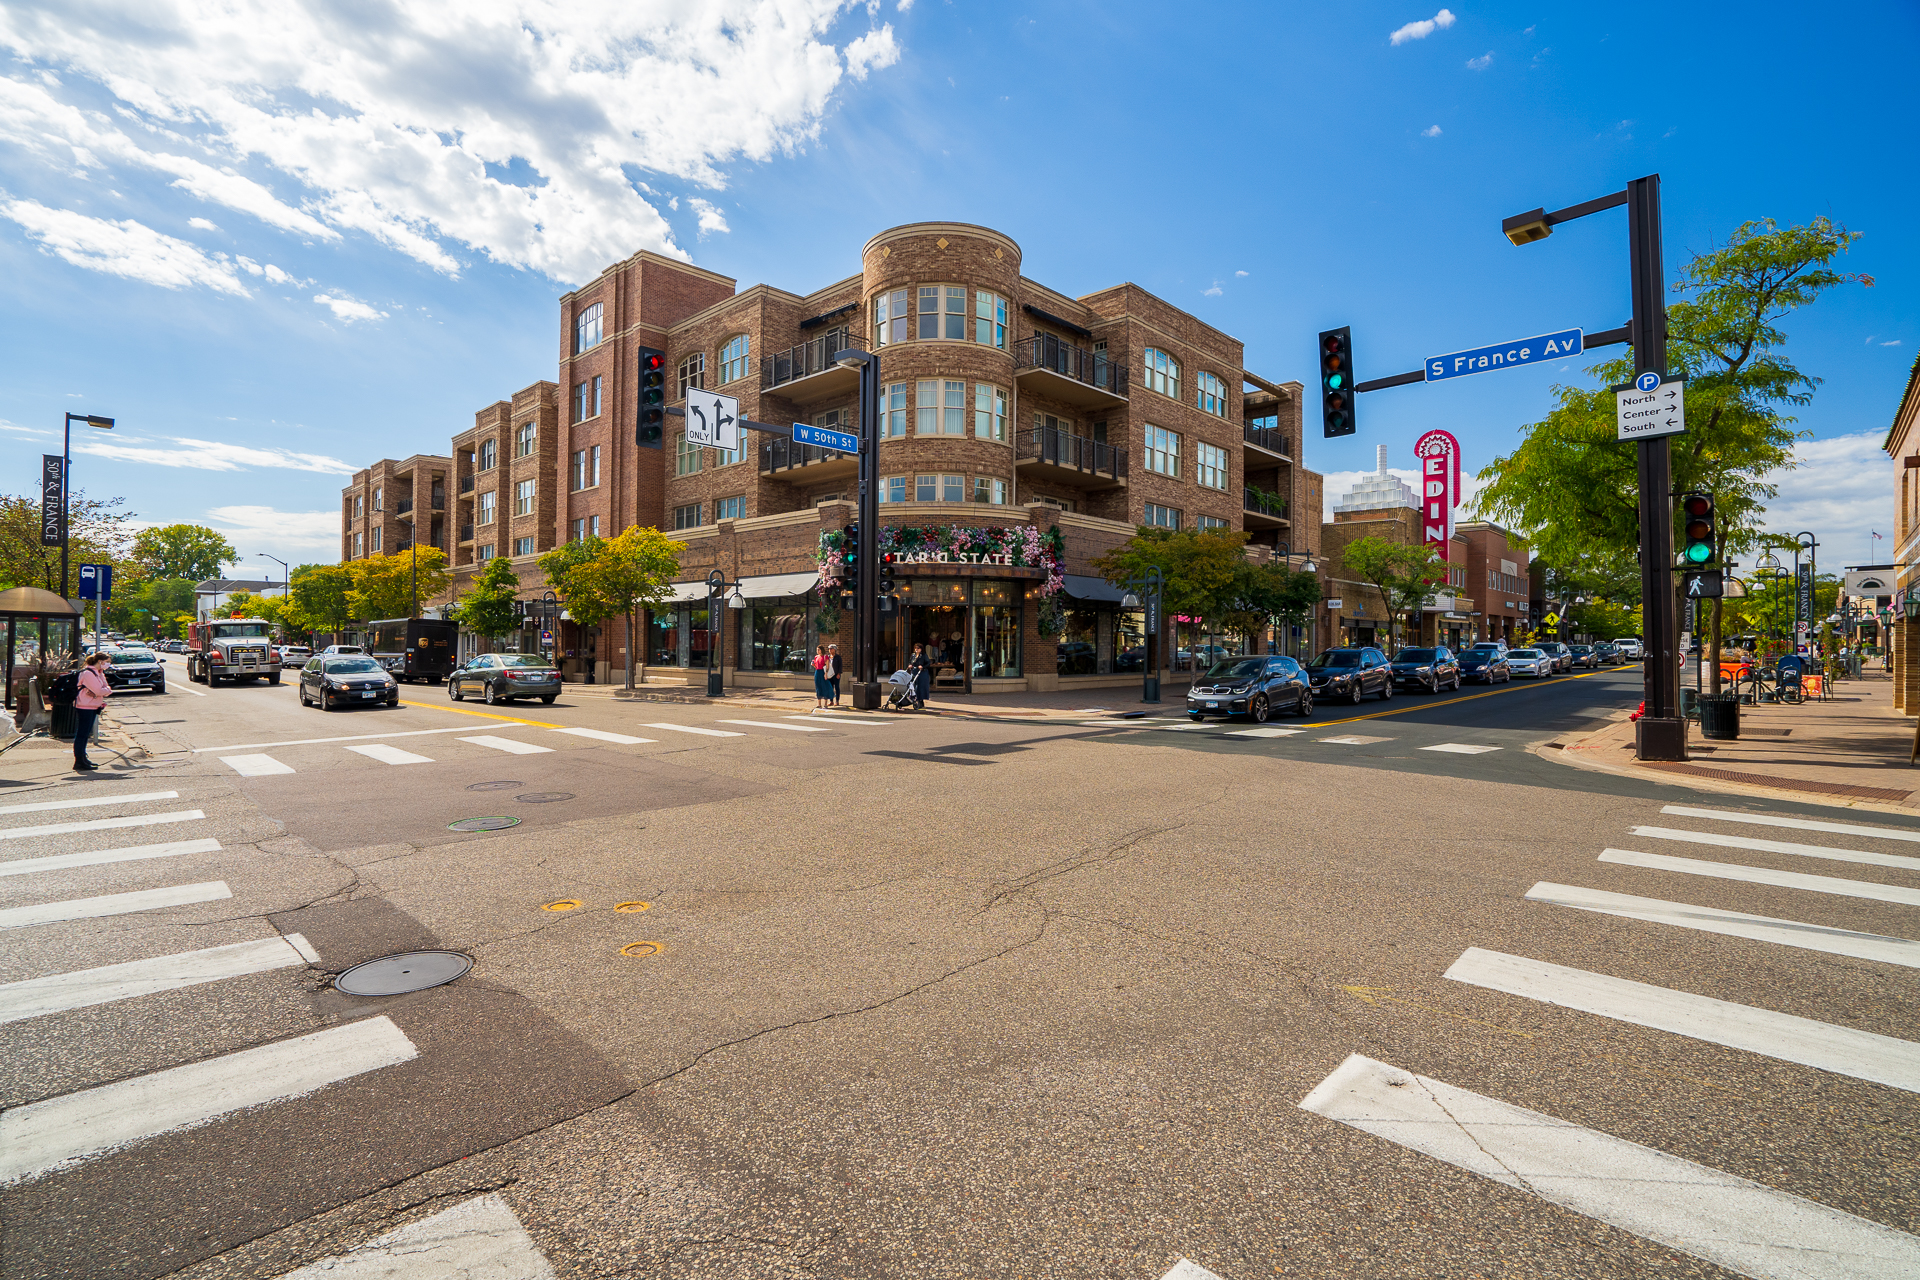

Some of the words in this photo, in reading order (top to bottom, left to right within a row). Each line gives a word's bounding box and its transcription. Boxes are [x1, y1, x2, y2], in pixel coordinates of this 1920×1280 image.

[1432, 361, 1444, 376] S
[1454, 347, 1531, 372] France
[1543, 338, 1574, 356] Av
[1643, 376, 1655, 389] P
[1622, 394, 1656, 406] North
[1623, 408, 1662, 419] Center
[1623, 421, 1656, 433] South
[689, 430, 710, 441] ONLY
[800, 428, 809, 439] W
[814, 431, 837, 445] 50th
[841, 437, 852, 448] St
[47, 460, 60, 480] 50th
[45, 481, 60, 493] &
[45, 495, 59, 540] FRANCE
[959, 552, 1013, 566] STATE
[1800, 590, 1809, 615] FRANCE
